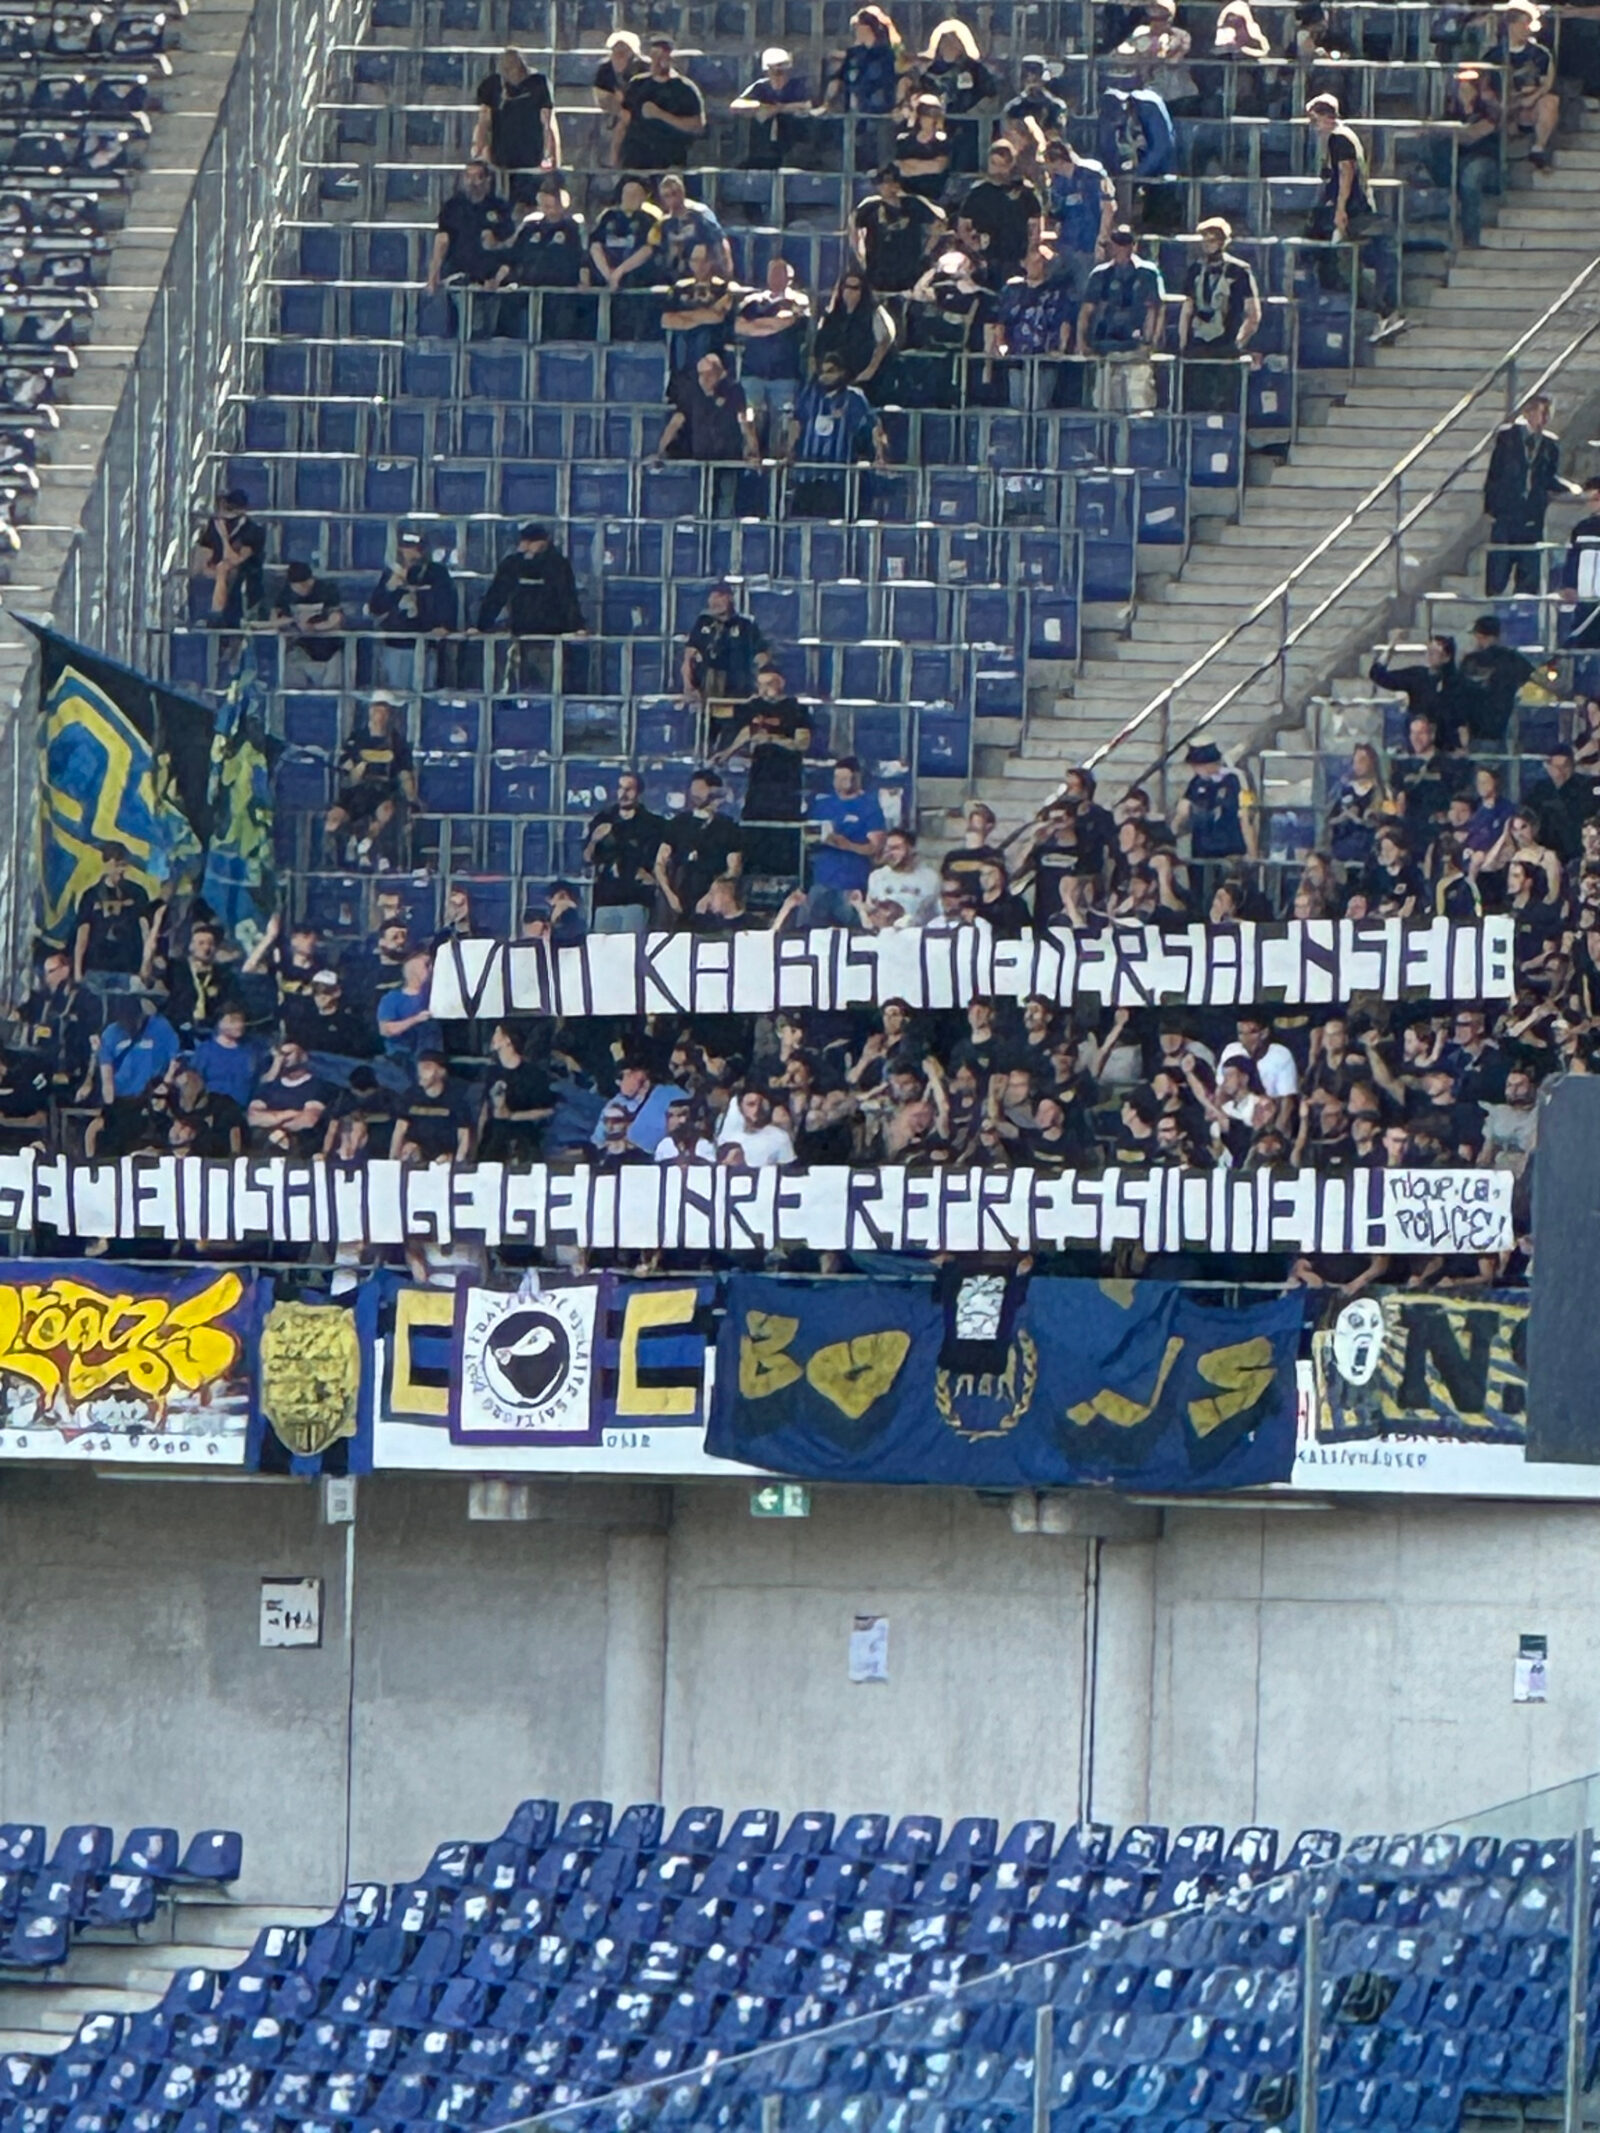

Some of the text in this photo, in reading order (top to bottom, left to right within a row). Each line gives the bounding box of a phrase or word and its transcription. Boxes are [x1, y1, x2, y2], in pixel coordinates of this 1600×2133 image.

[449, 933, 593, 1018] VON
[634, 930, 736, 1014] KA
[401, 1161, 622, 1248] GEGEN
[848, 1164, 1385, 1253] REPRESSIONEN!
